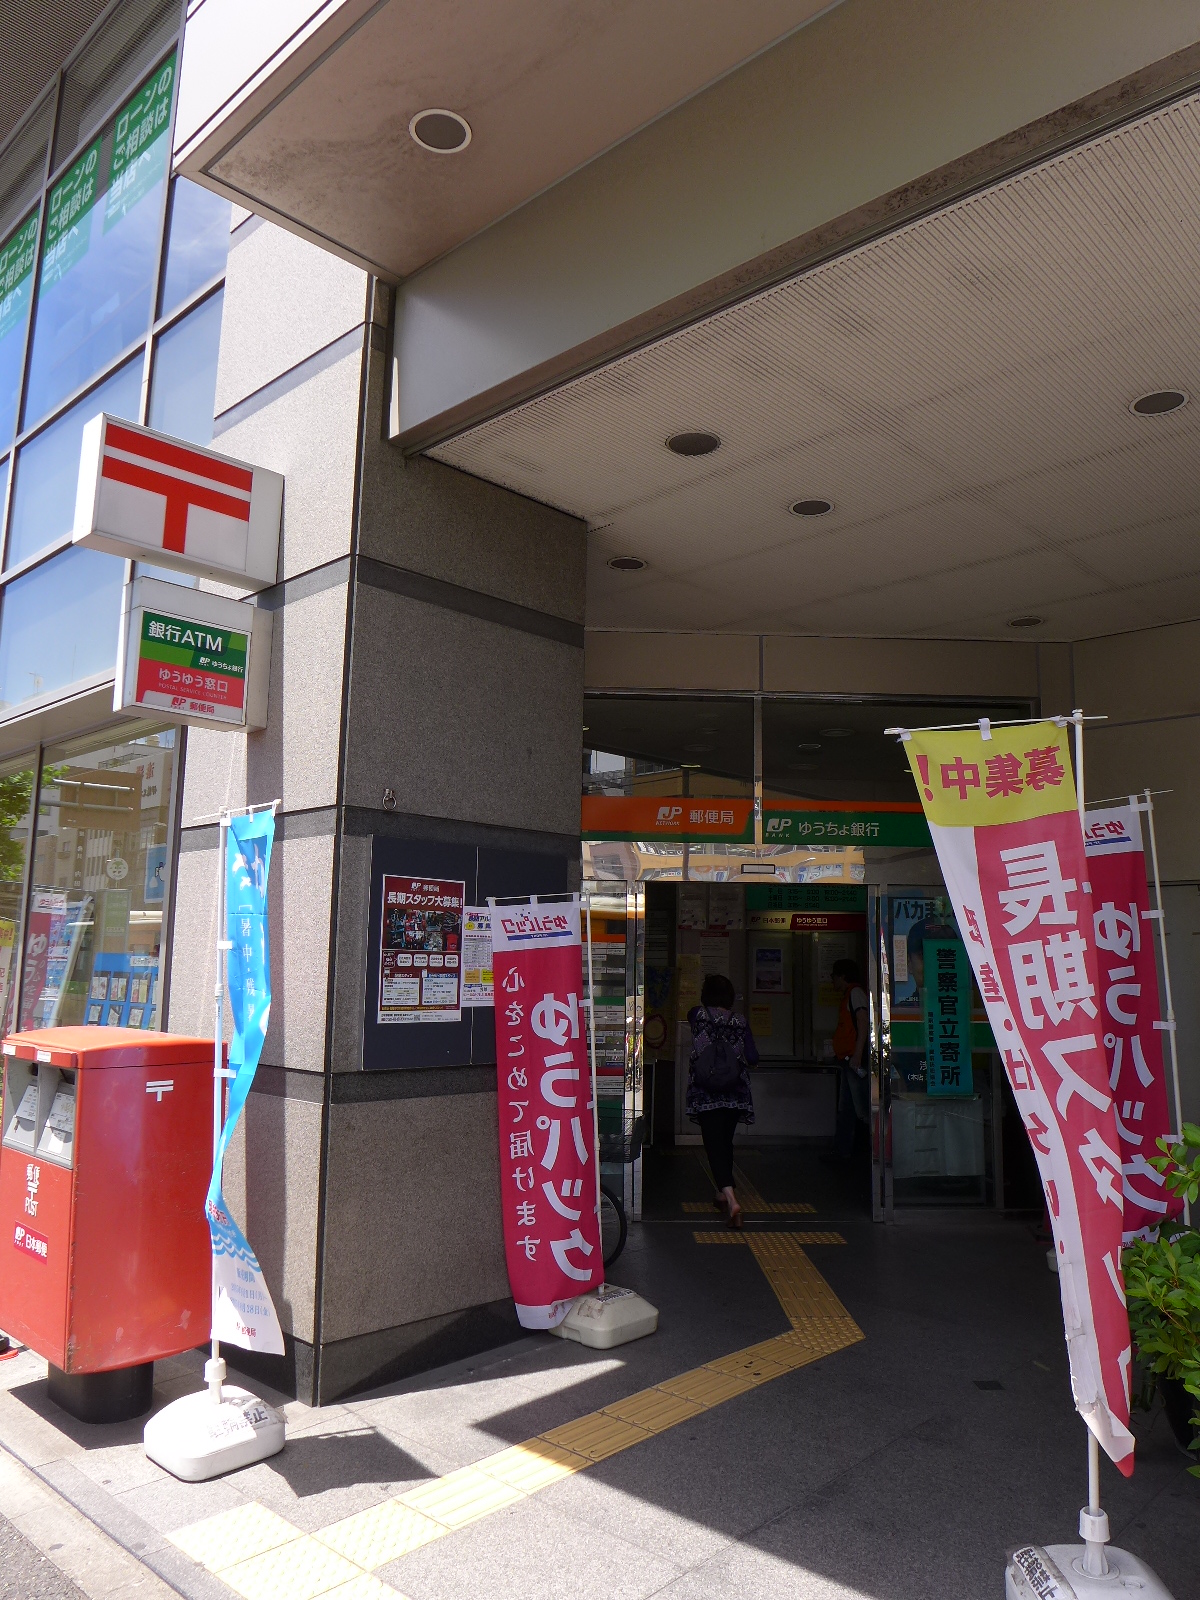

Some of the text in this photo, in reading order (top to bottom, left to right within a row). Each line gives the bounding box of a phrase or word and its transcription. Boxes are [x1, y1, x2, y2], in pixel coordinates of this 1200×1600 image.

[116, 66, 172, 143] ローンの
[113, 97, 169, 170] ご相談は
[51, 149, 97, 214] ローンの
[48, 176, 94, 240] ご相談は
[148, 620, 223, 653] 銀行ATM
[211, 660, 244, 674] ゆうちょ銀行
[158, 667, 229, 693] ゆうゆう窓口
[189, 701, 215, 714] 郵便局
[656, 806, 734, 825] JP 郵便局
[767, 818, 881, 838] JP ゆうちょ銀行
[387, 891, 463, 909] 長期スタッフ大募集!
[936, 948, 961, 1087] 警察官立寄所
[24, 1196, 39, 1217] POST
[25, 1233, 48, 1258] 日本郵便
